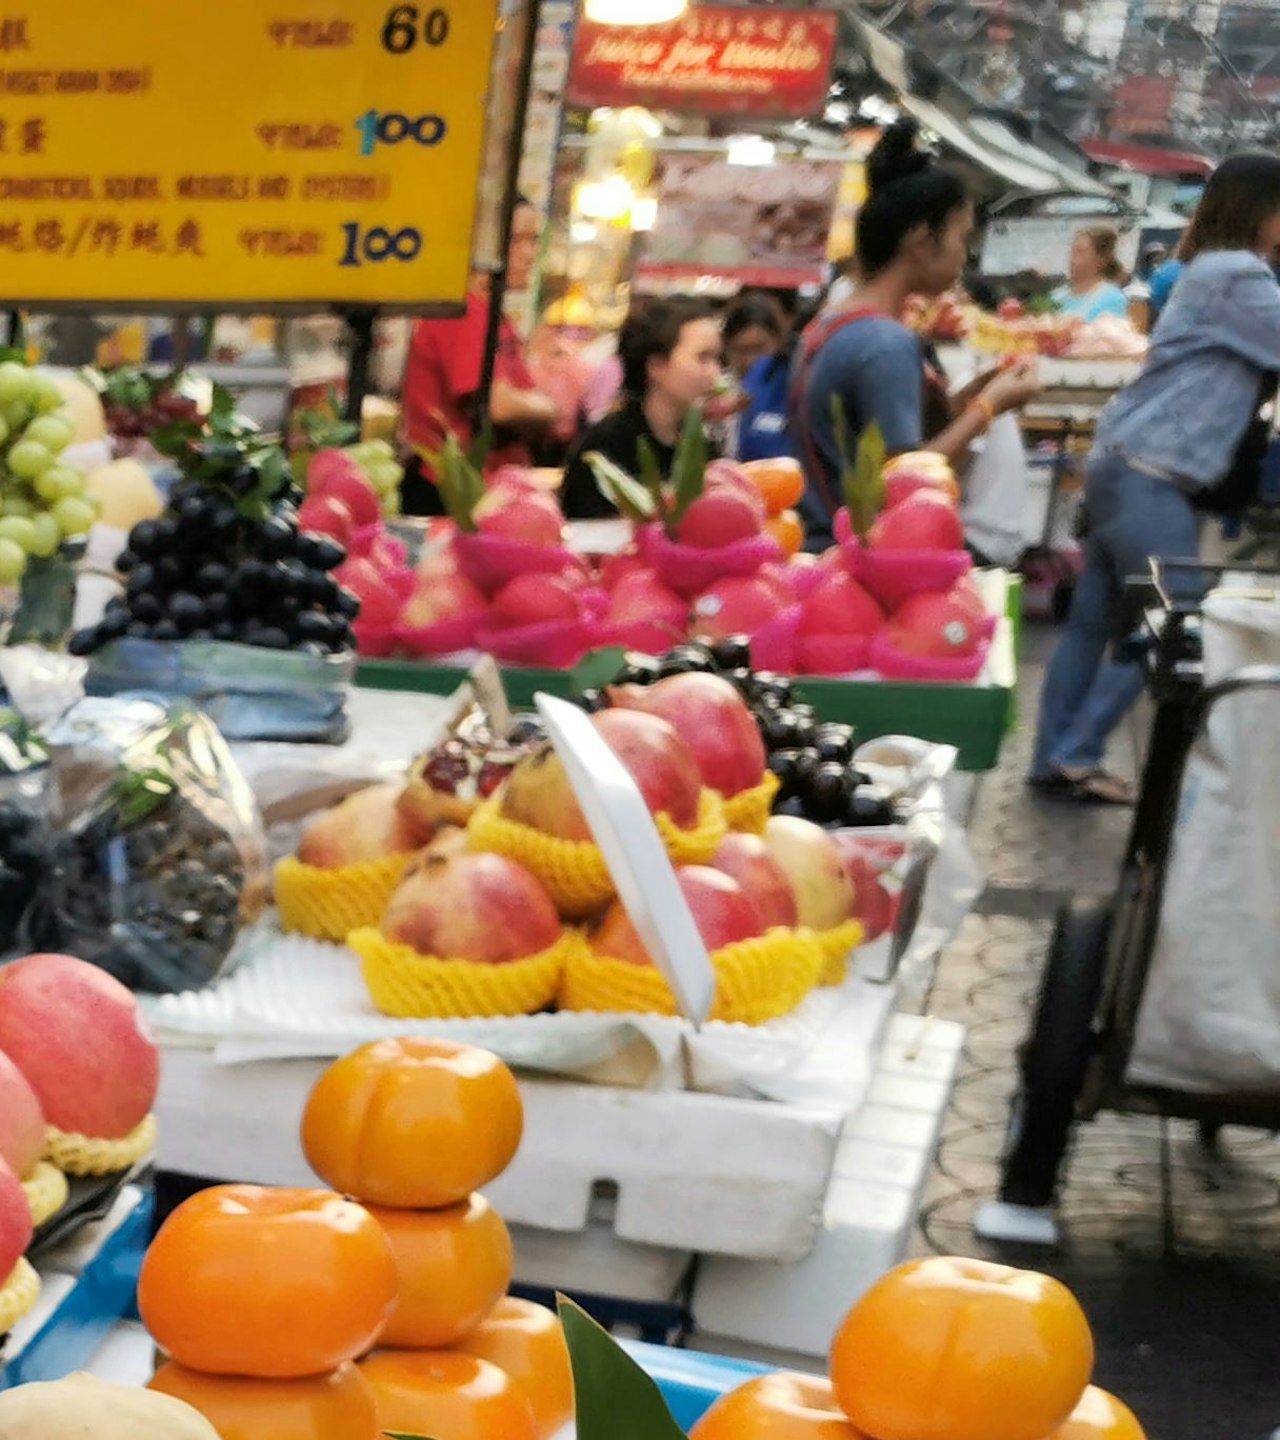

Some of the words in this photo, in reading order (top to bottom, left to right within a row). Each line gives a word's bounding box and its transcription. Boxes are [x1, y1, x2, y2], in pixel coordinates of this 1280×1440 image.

[382, 5, 450, 54] 60
[355, 109, 447, 156] 100
[338, 222, 424, 267] 100
